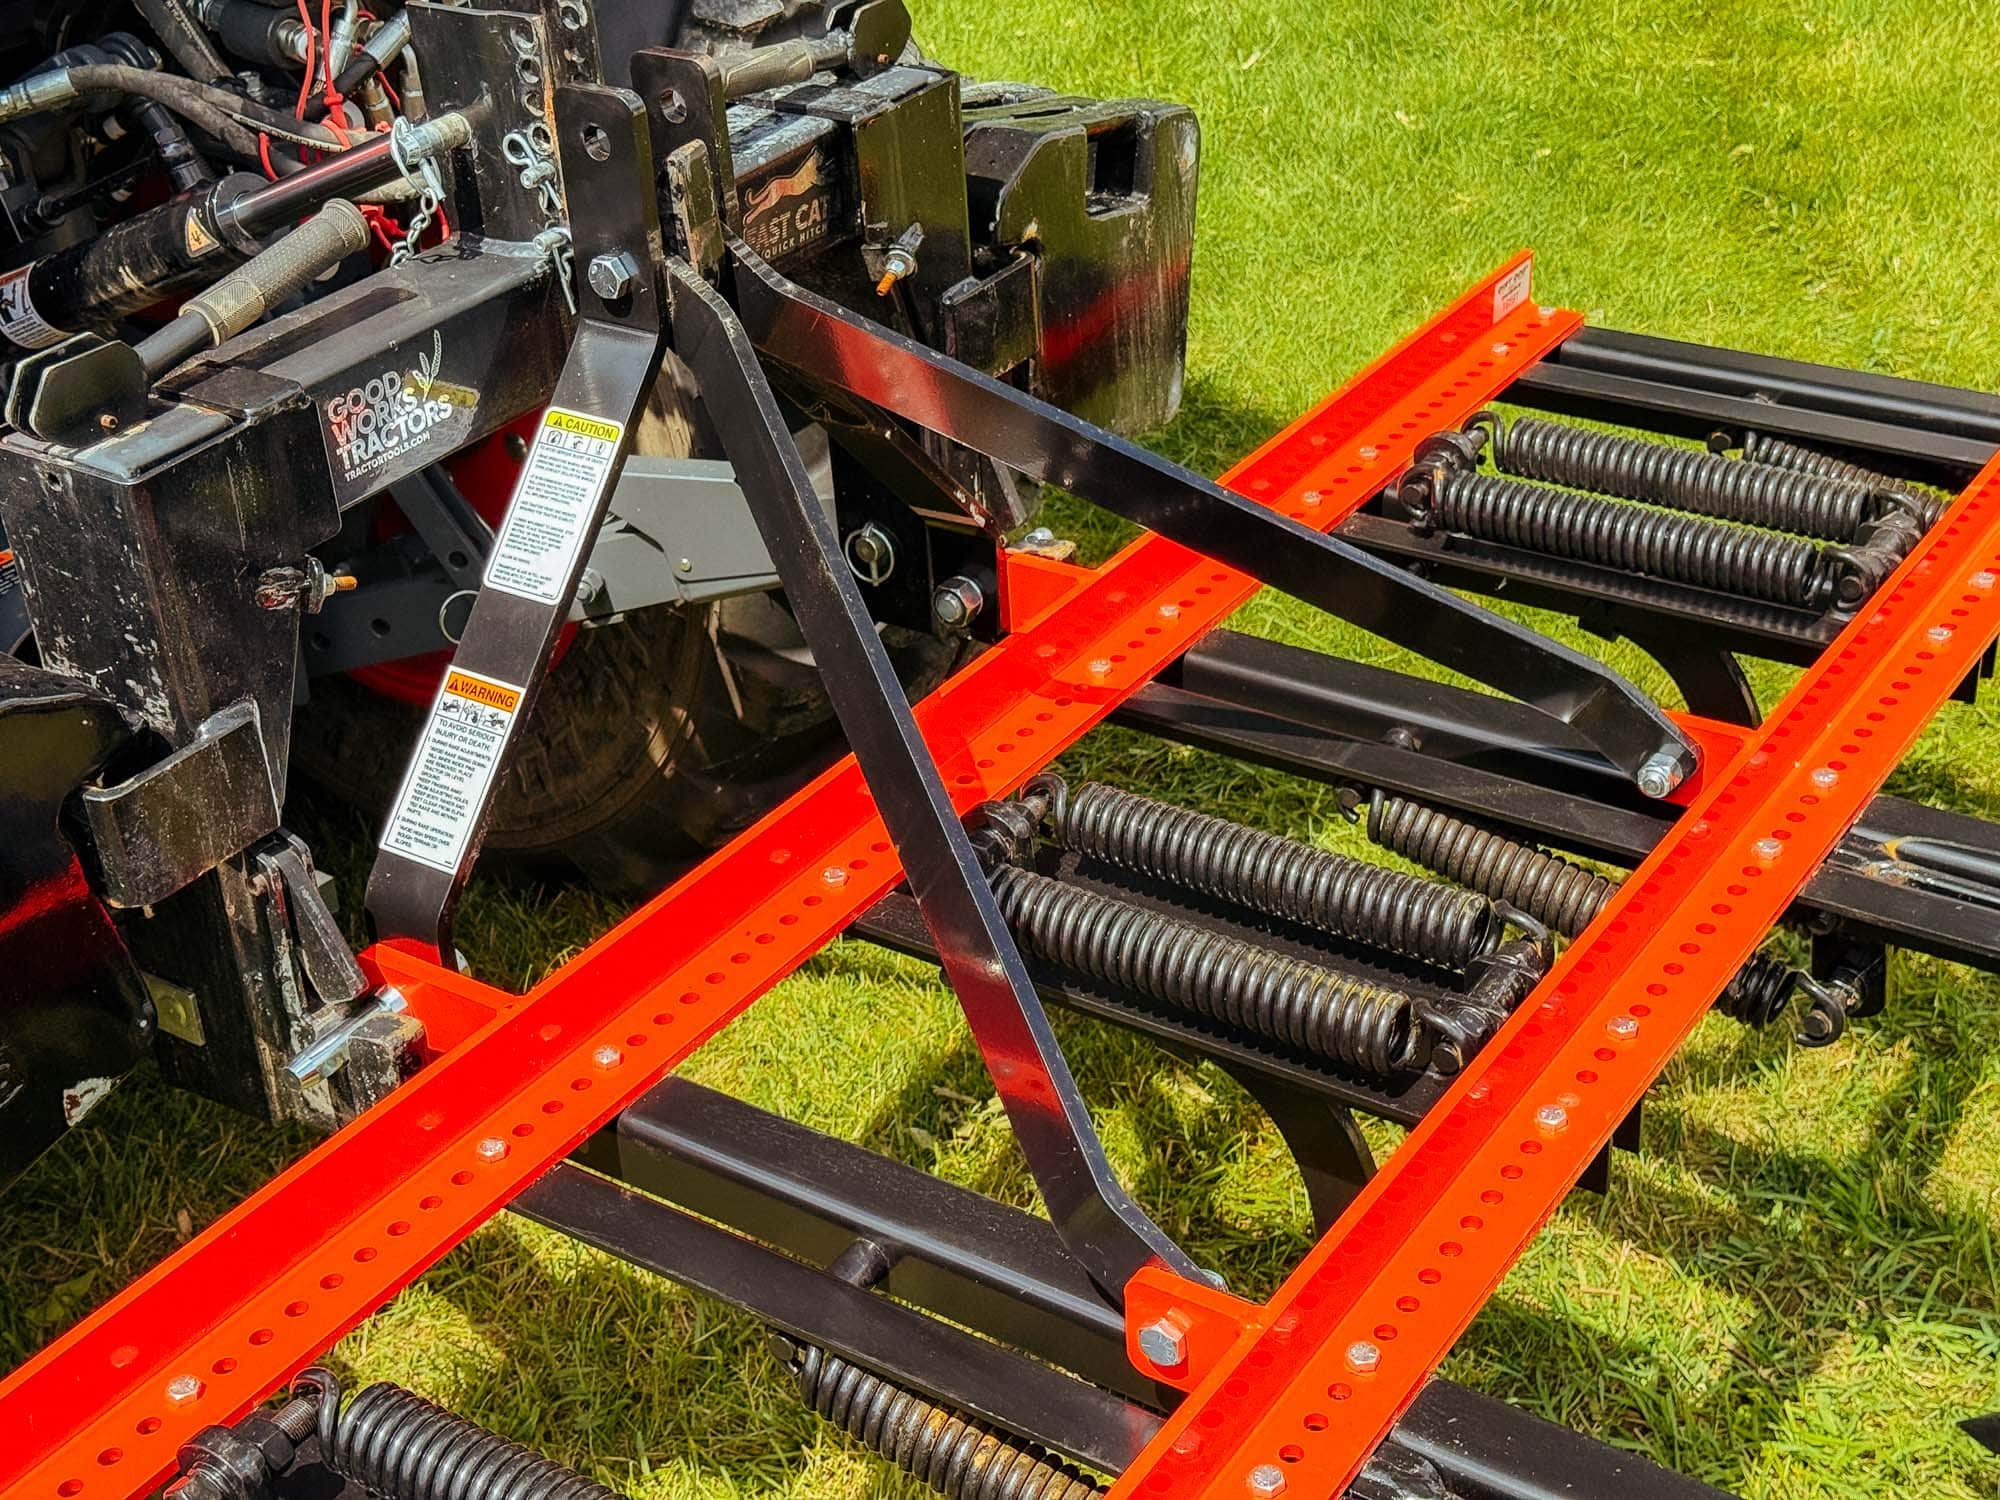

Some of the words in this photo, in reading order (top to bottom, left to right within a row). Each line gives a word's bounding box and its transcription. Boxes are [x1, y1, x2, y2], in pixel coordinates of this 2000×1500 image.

[764, 237, 794, 259] QUICK
[327, 370, 400, 424] GOOD
[331, 387, 417, 447] WORKS
[564, 418, 614, 438] CAUTION
[336, 394, 452, 470] TRACTORS
[344, 433, 430, 482] TRACTORTOOLS.COM
[458, 680, 516, 708] WARNING
[434, 727, 457, 740] INJURY
[457, 734, 468, 744] OR
[438, 718, 449, 727] TO
[447, 721, 468, 733] AVOID
[467, 728, 496, 743] SERIOUS
